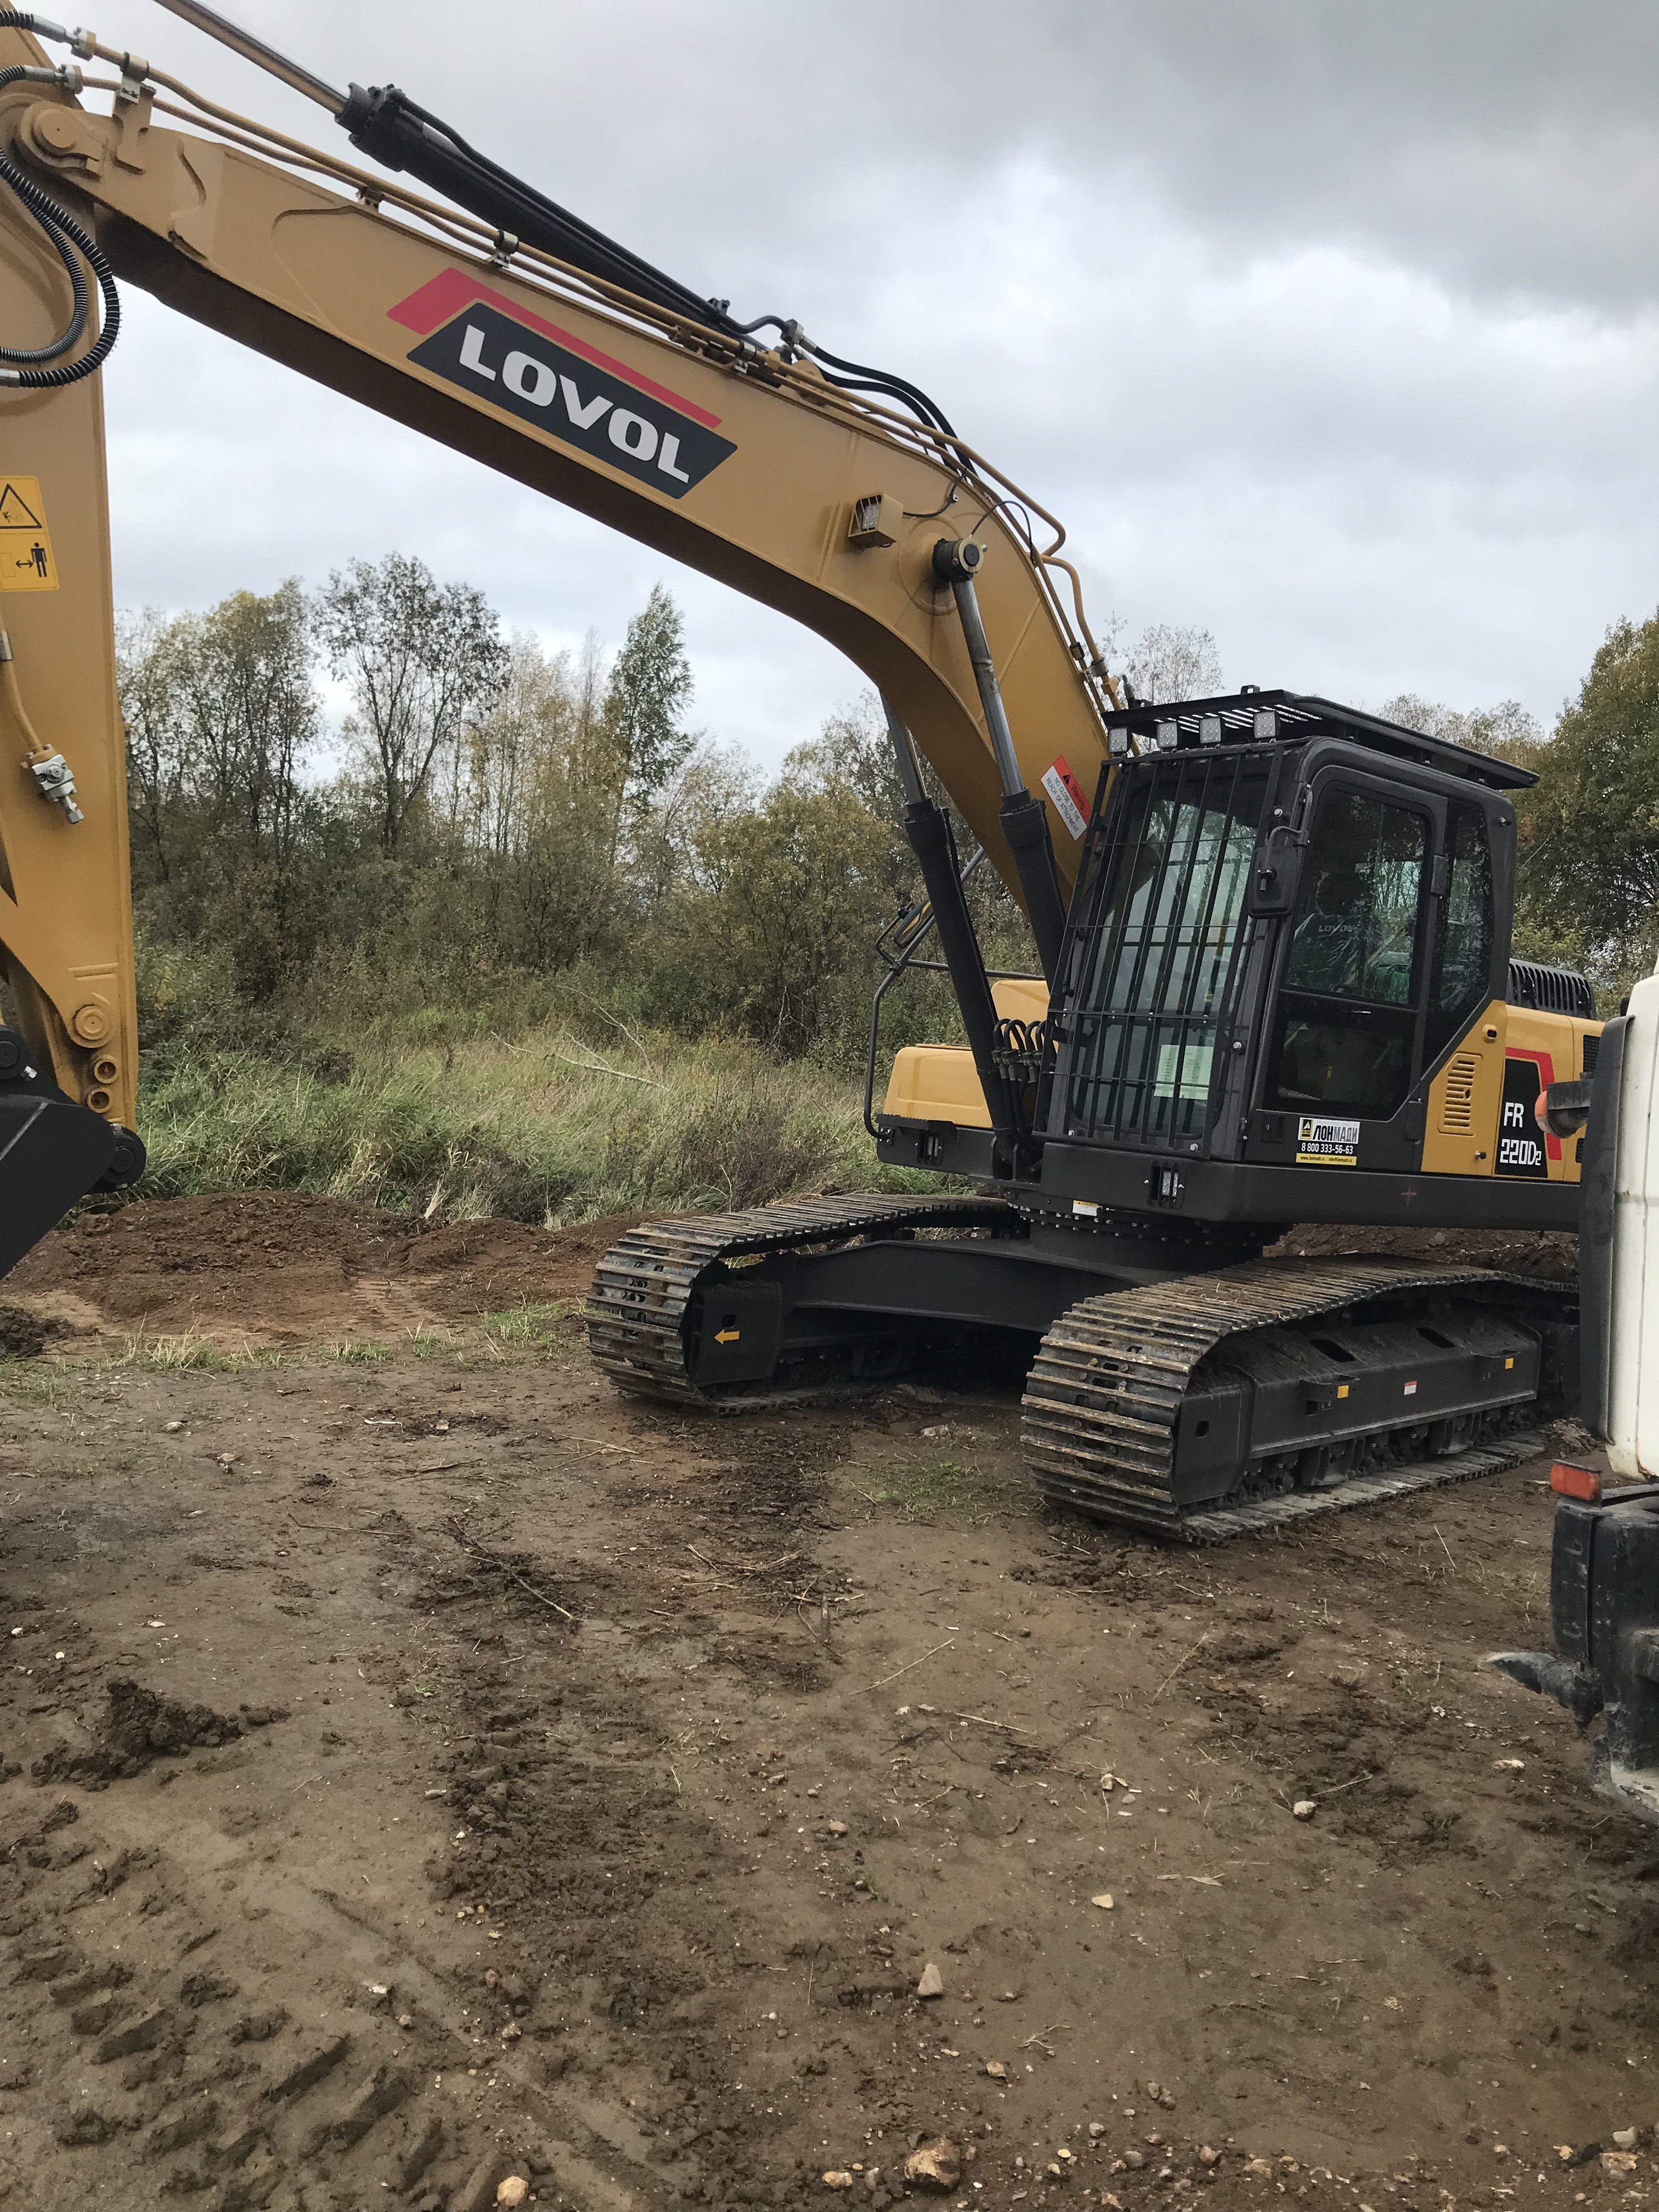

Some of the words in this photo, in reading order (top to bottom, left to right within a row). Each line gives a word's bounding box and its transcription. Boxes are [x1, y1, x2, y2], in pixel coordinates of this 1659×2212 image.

[459, 324, 690, 484] LOVOL
[1046, 777, 1058, 795] REACH
[1060, 803, 1079, 833] ATTACHMENT
[1054, 777, 1060, 786] NO
[1059, 787, 1070, 803] CLOSE
[1069, 802, 1074, 811] TO
[1071, 785, 1086, 810] Warning
[1504, 1102, 1524, 1127] FR
[1312, 1125, 1357, 1142] ЛОНМАДИ
[1301, 1143, 1306, 1152] 8
[1307, 1143, 1319, 1153] 800
[1321, 1144, 1353, 1154] 333-56-63
[1500, 1138, 1542, 1166] 220D2
